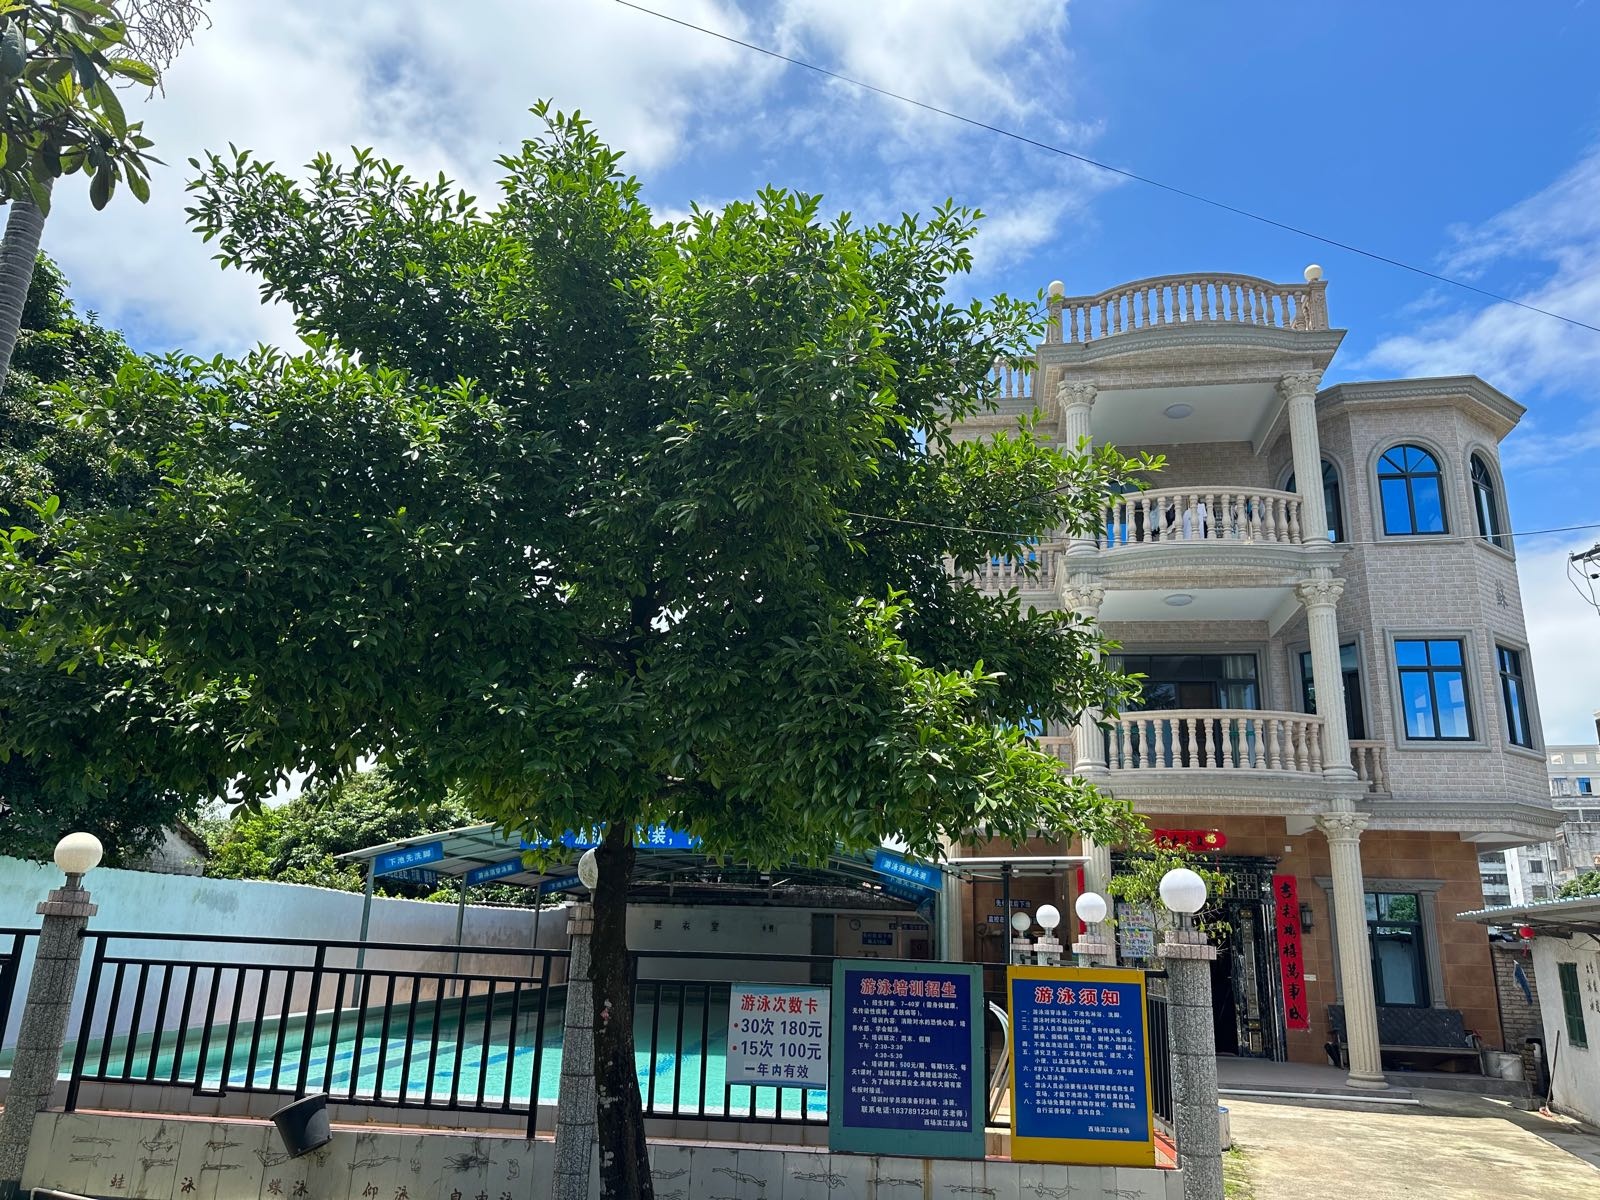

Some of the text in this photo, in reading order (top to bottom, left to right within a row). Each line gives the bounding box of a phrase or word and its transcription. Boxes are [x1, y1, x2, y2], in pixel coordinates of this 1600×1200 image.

[388, 849, 432, 866] 下池先洗脚
[653, 919, 720, 933] 更衣室
[860, 977, 957, 998] 游泳培训招生
[1035, 986, 1120, 1006] 游泳须知
[741, 994, 819, 1015] 游泳次数卡
[741, 1017, 823, 1038] 30次 180元
[741, 1040, 822, 1060] 15次 100元
[874, 1051, 903, 1059] 4:30-5:30
[744, 1062, 809, 1079] 一年内有效
[923, 1118, 968, 1128] 西场滨江游泳场
[1087, 1125, 1130, 1134] 西场滨江游泳场
[361, 1181, 410, 1200] 仰泳
